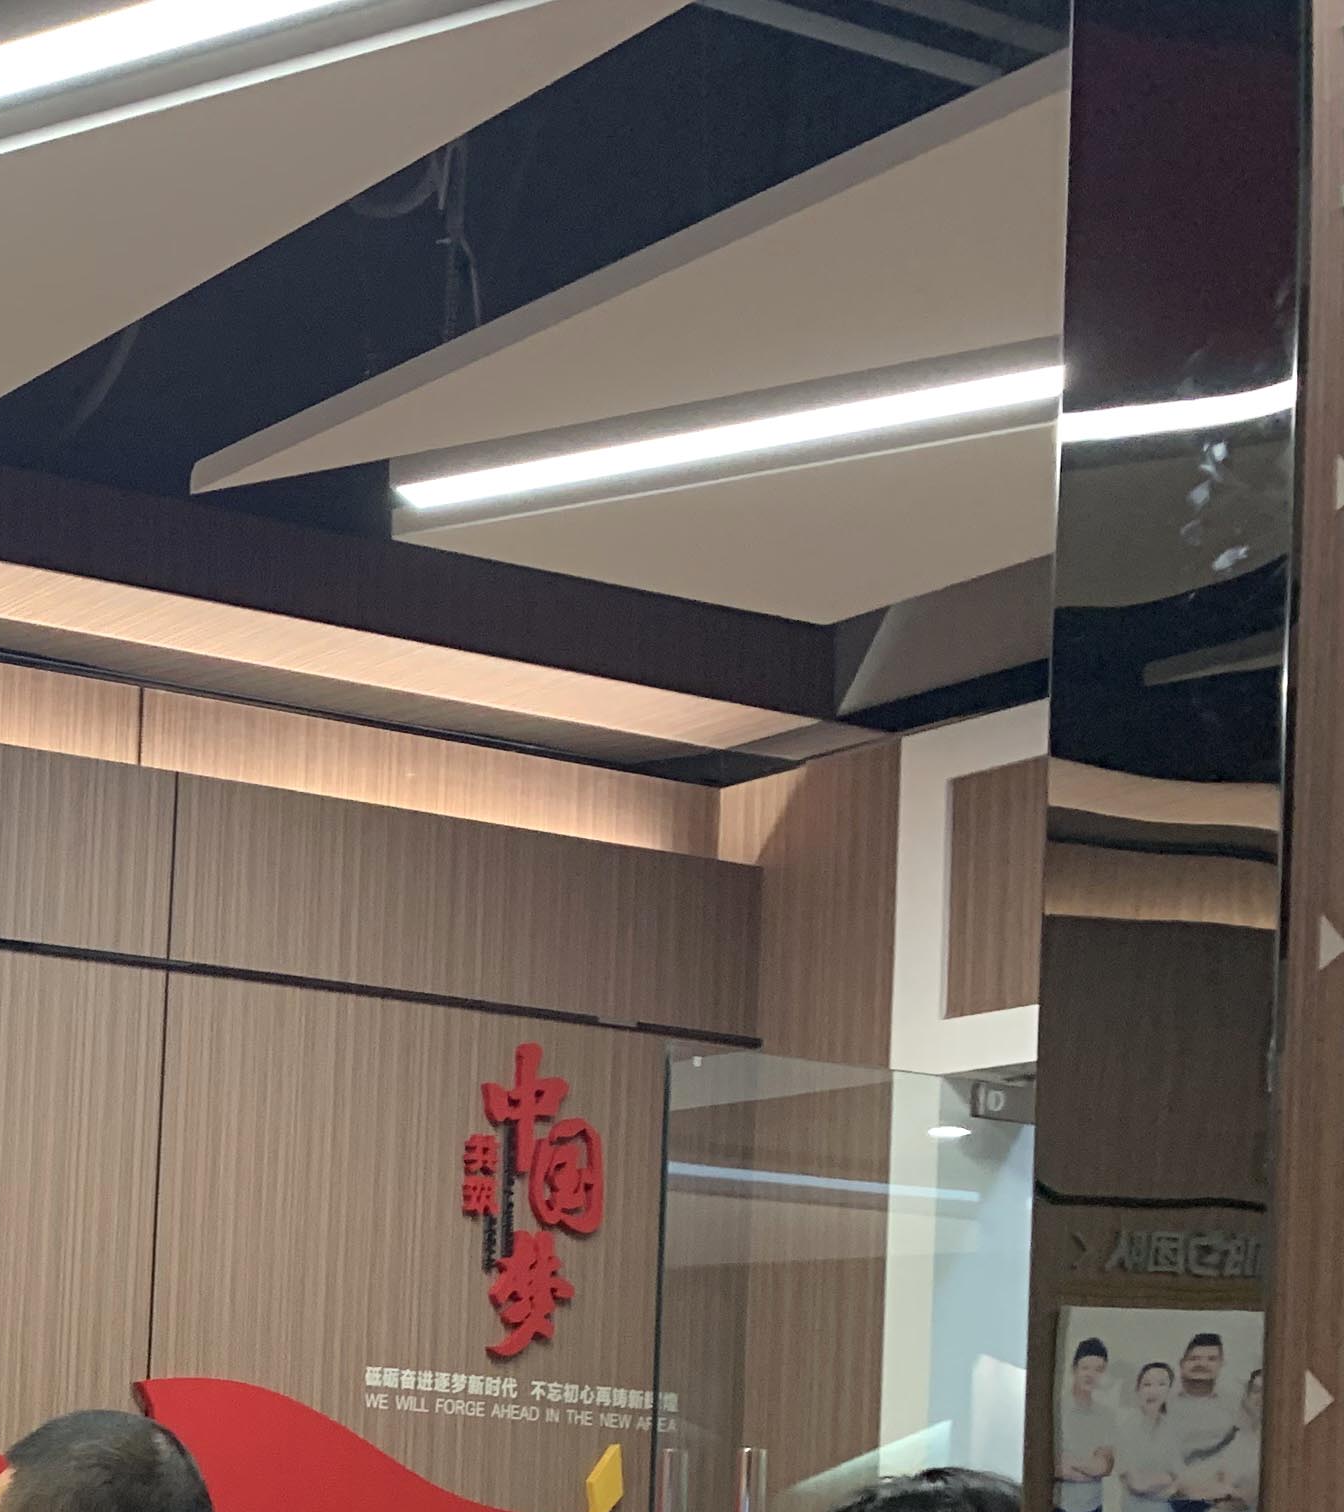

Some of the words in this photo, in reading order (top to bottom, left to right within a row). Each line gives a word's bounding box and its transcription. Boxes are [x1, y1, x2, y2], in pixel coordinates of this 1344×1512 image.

[365, 1393, 388, 1410] WE
[395, 1395, 430, 1413] WILL
[434, 1398, 486, 1418] FORGE
[491, 1403, 540, 1422] AHEAD
[545, 1407, 560, 1424] IN
[566, 1409, 593, 1427] THE
[599, 1413, 632, 1430] NEW
